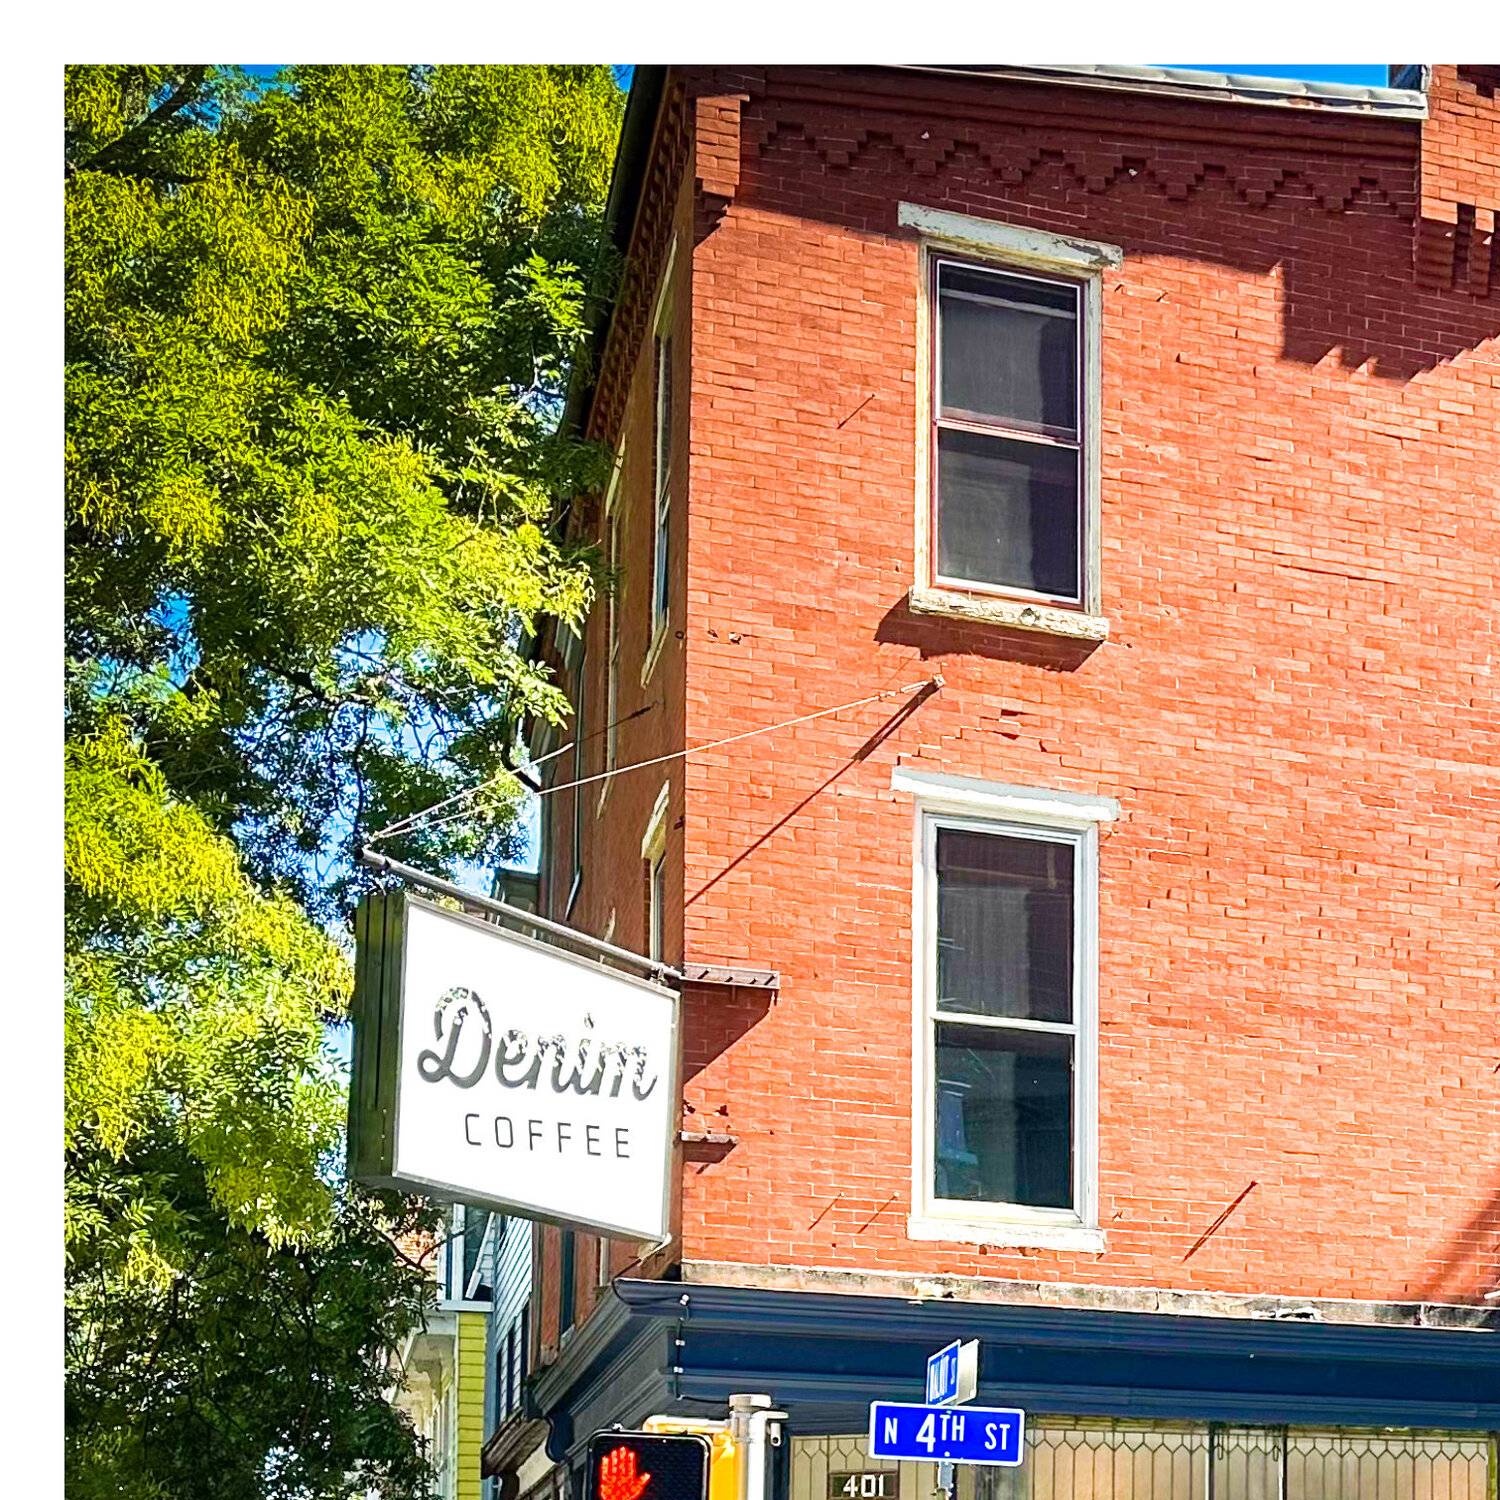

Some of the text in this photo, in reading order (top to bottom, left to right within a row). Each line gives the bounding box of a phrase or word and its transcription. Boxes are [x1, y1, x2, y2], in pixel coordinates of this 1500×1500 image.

[417, 986, 657, 1101] Denim
[464, 1114, 630, 1158] COFFEE
[884, 1413, 1010, 1452] N 4TH ST
[843, 1475, 884, 1497] 401
